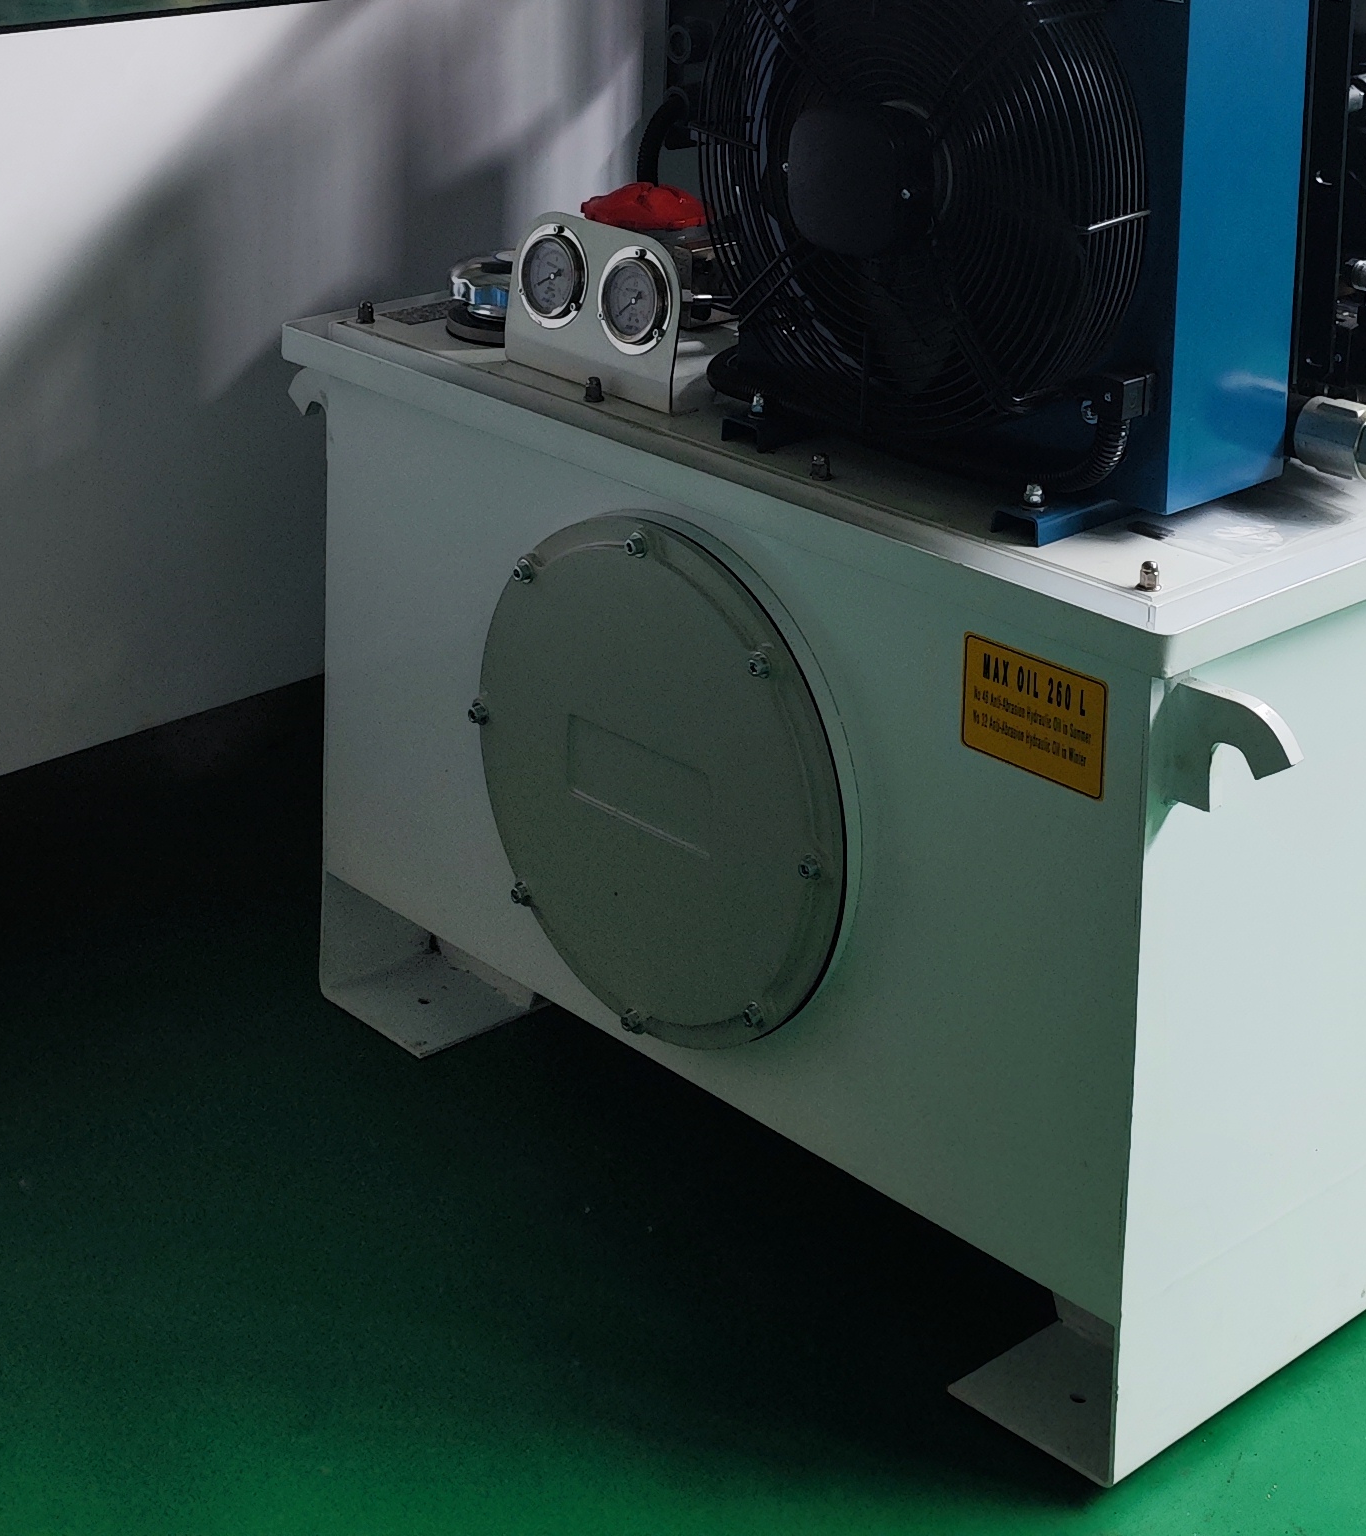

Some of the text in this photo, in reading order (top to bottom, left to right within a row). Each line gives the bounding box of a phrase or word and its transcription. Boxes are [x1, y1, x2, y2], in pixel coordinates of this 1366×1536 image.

[983, 653, 1086, 716] MAX OIL 260 L
